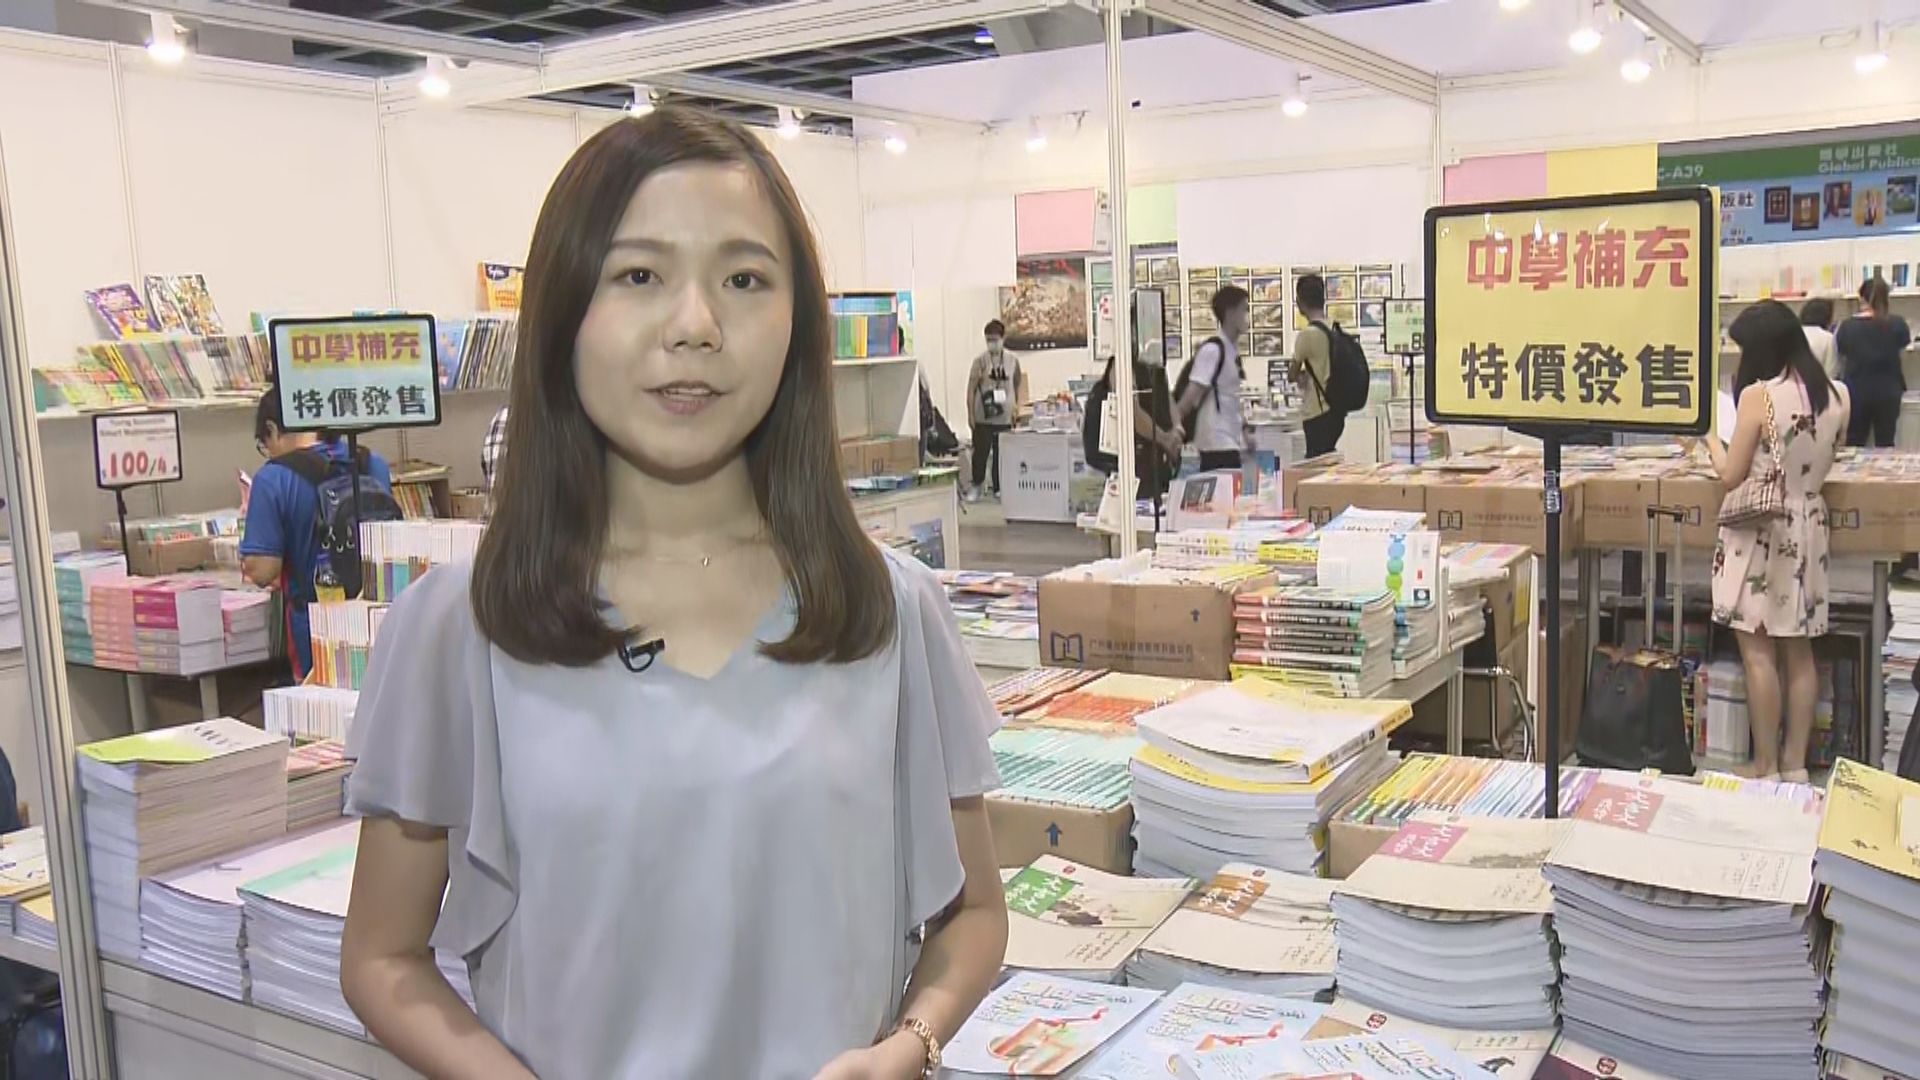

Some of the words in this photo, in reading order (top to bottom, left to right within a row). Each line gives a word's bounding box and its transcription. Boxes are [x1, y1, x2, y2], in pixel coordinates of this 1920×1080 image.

[1466, 225, 1692, 291] 中學補充
[291, 331, 421, 363] 中學補充
[1460, 341, 1694, 409] 特價發售
[292, 384, 426, 419] 特價發售
